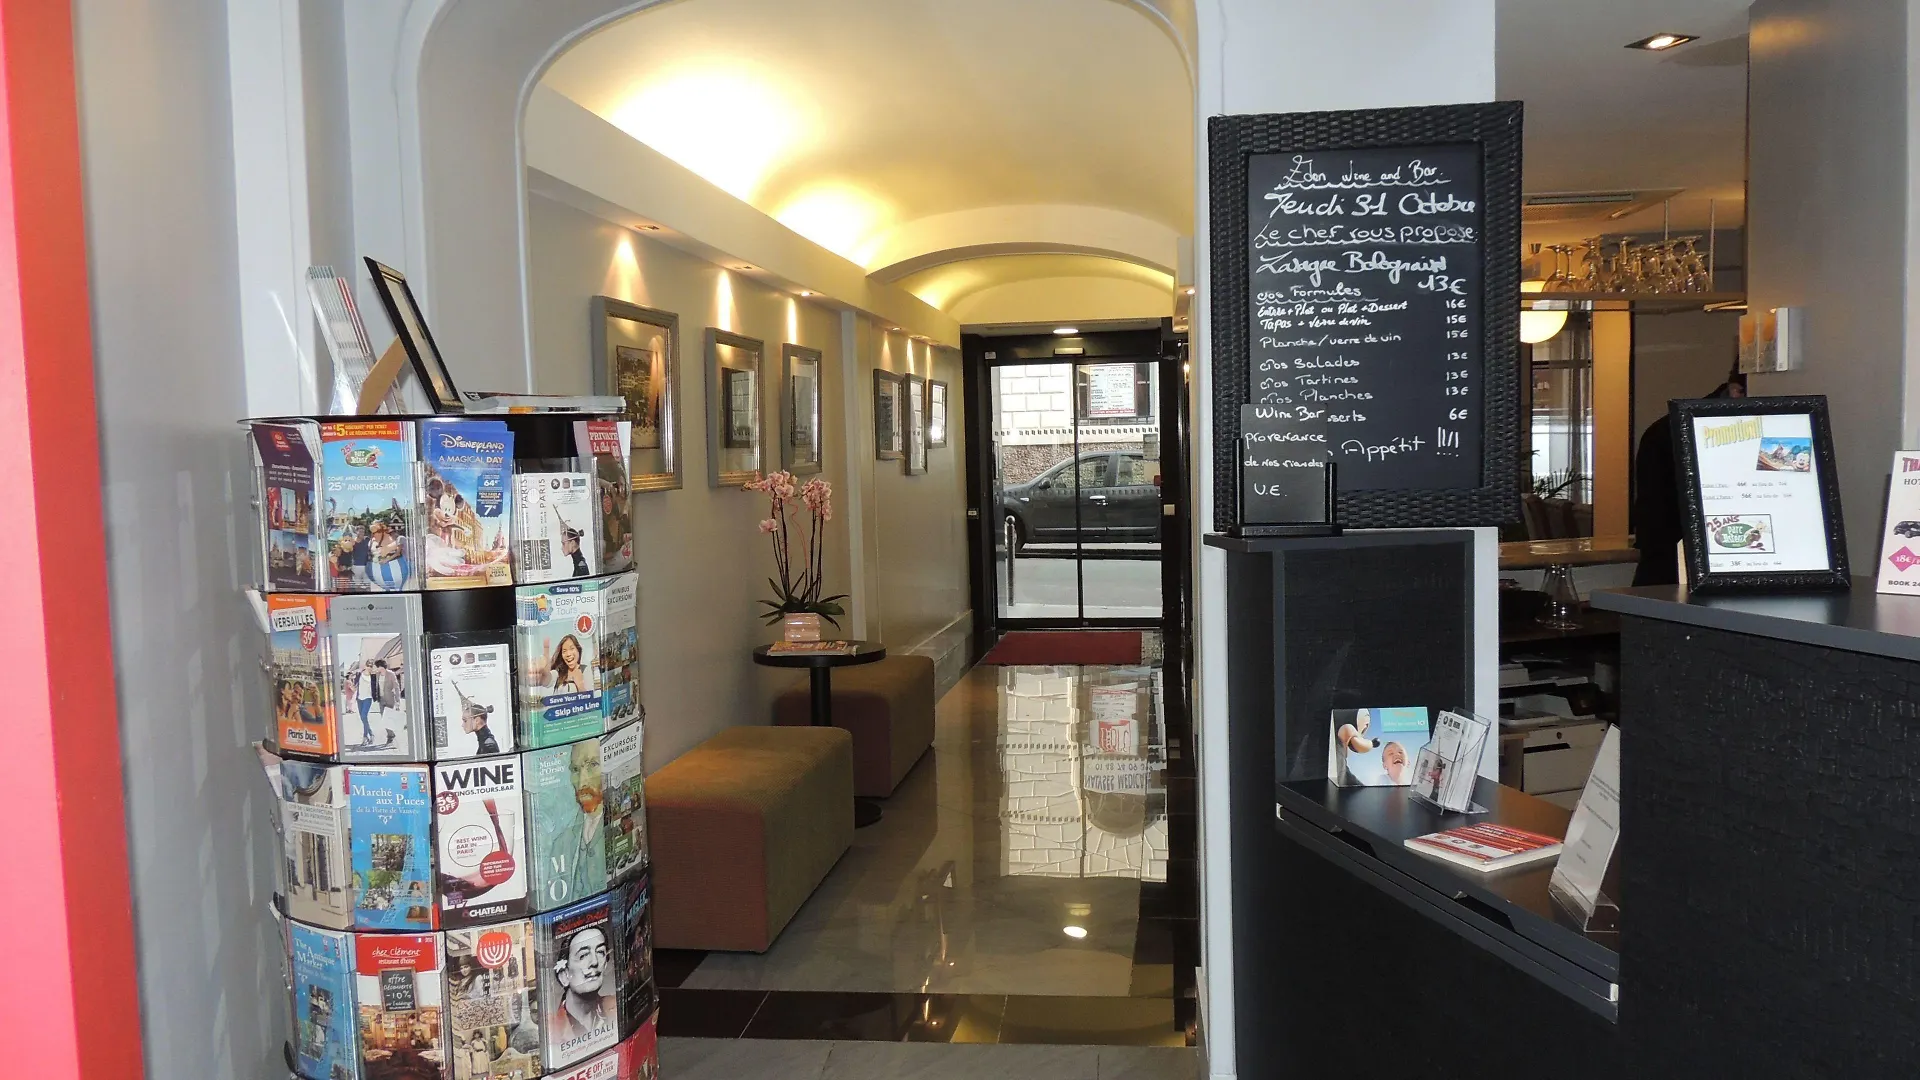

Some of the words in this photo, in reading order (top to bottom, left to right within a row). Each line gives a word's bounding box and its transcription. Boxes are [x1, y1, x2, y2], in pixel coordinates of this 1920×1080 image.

[1380, 166, 1401, 180] and
[1351, 194, 1388, 216] 31
[1287, 225, 1344, 240] chef
[1290, 282, 1362, 298] Formules
[1417, 275, 1468, 295] 13€
[1445, 299, 1467, 309] 16€
[1259, 319, 1292, 332] Tapas
[1446, 314, 1467, 324] 15€
[1446, 329, 1469, 339] 15€
[1293, 355, 1360, 369] Salades
[1446, 351, 1468, 361] 13€
[1295, 374, 1359, 387] Tartines
[1446, 370, 1469, 381] 13€
[1299, 387, 1374, 401] Planches
[1445, 386, 1469, 397] 13€
[1254, 405, 1293, 420] Wine
[1295, 406, 1325, 422] Bar
[1448, 409, 1468, 421] 6€
[446, 455, 484, 463] MAGICAL
[486, 456, 504, 464] DAY
[1244, 458, 1260, 467] de
[347, 482, 399, 491] ANNIVERSARY
[538, 478, 546, 509] PARIS
[1706, 517, 1722, 533] 25
[1722, 515, 1740, 526] ANS
[611, 585, 630, 595] MINIBUS
[555, 597, 575, 607] Easy
[575, 595, 596, 604] Pass
[557, 607, 578, 615] Tours
[273, 614, 315, 627] VERSAILLES
[433, 654, 443, 685] PARIS
[577, 692, 592, 700] Time
[554, 708, 571, 717] Skip
[572, 704, 584, 713] the
[585, 701, 600, 710] Line
[287, 729, 304, 740] Paris
[304, 729, 317, 741] bus
[603, 753, 612, 762] EM
[613, 742, 637, 758] MINIBUS
[441, 764, 514, 790] WINE
[352, 784, 393, 797] Marché
[395, 793, 425, 806] Puces
[437, 794, 456, 806] 5€
[439, 801, 457, 812] OFF
[469, 905, 508, 918] CHATEAU
[295, 937, 307, 949] The
[307, 946, 336, 967] Antique
[371, 946, 389, 956] chez
[390, 946, 422, 957] Clément
[296, 950, 323, 969] Market
[388, 973, 406, 984] offre
[560, 1031, 592, 1052] ESPACE
[592, 1061, 604, 1074] OFF
